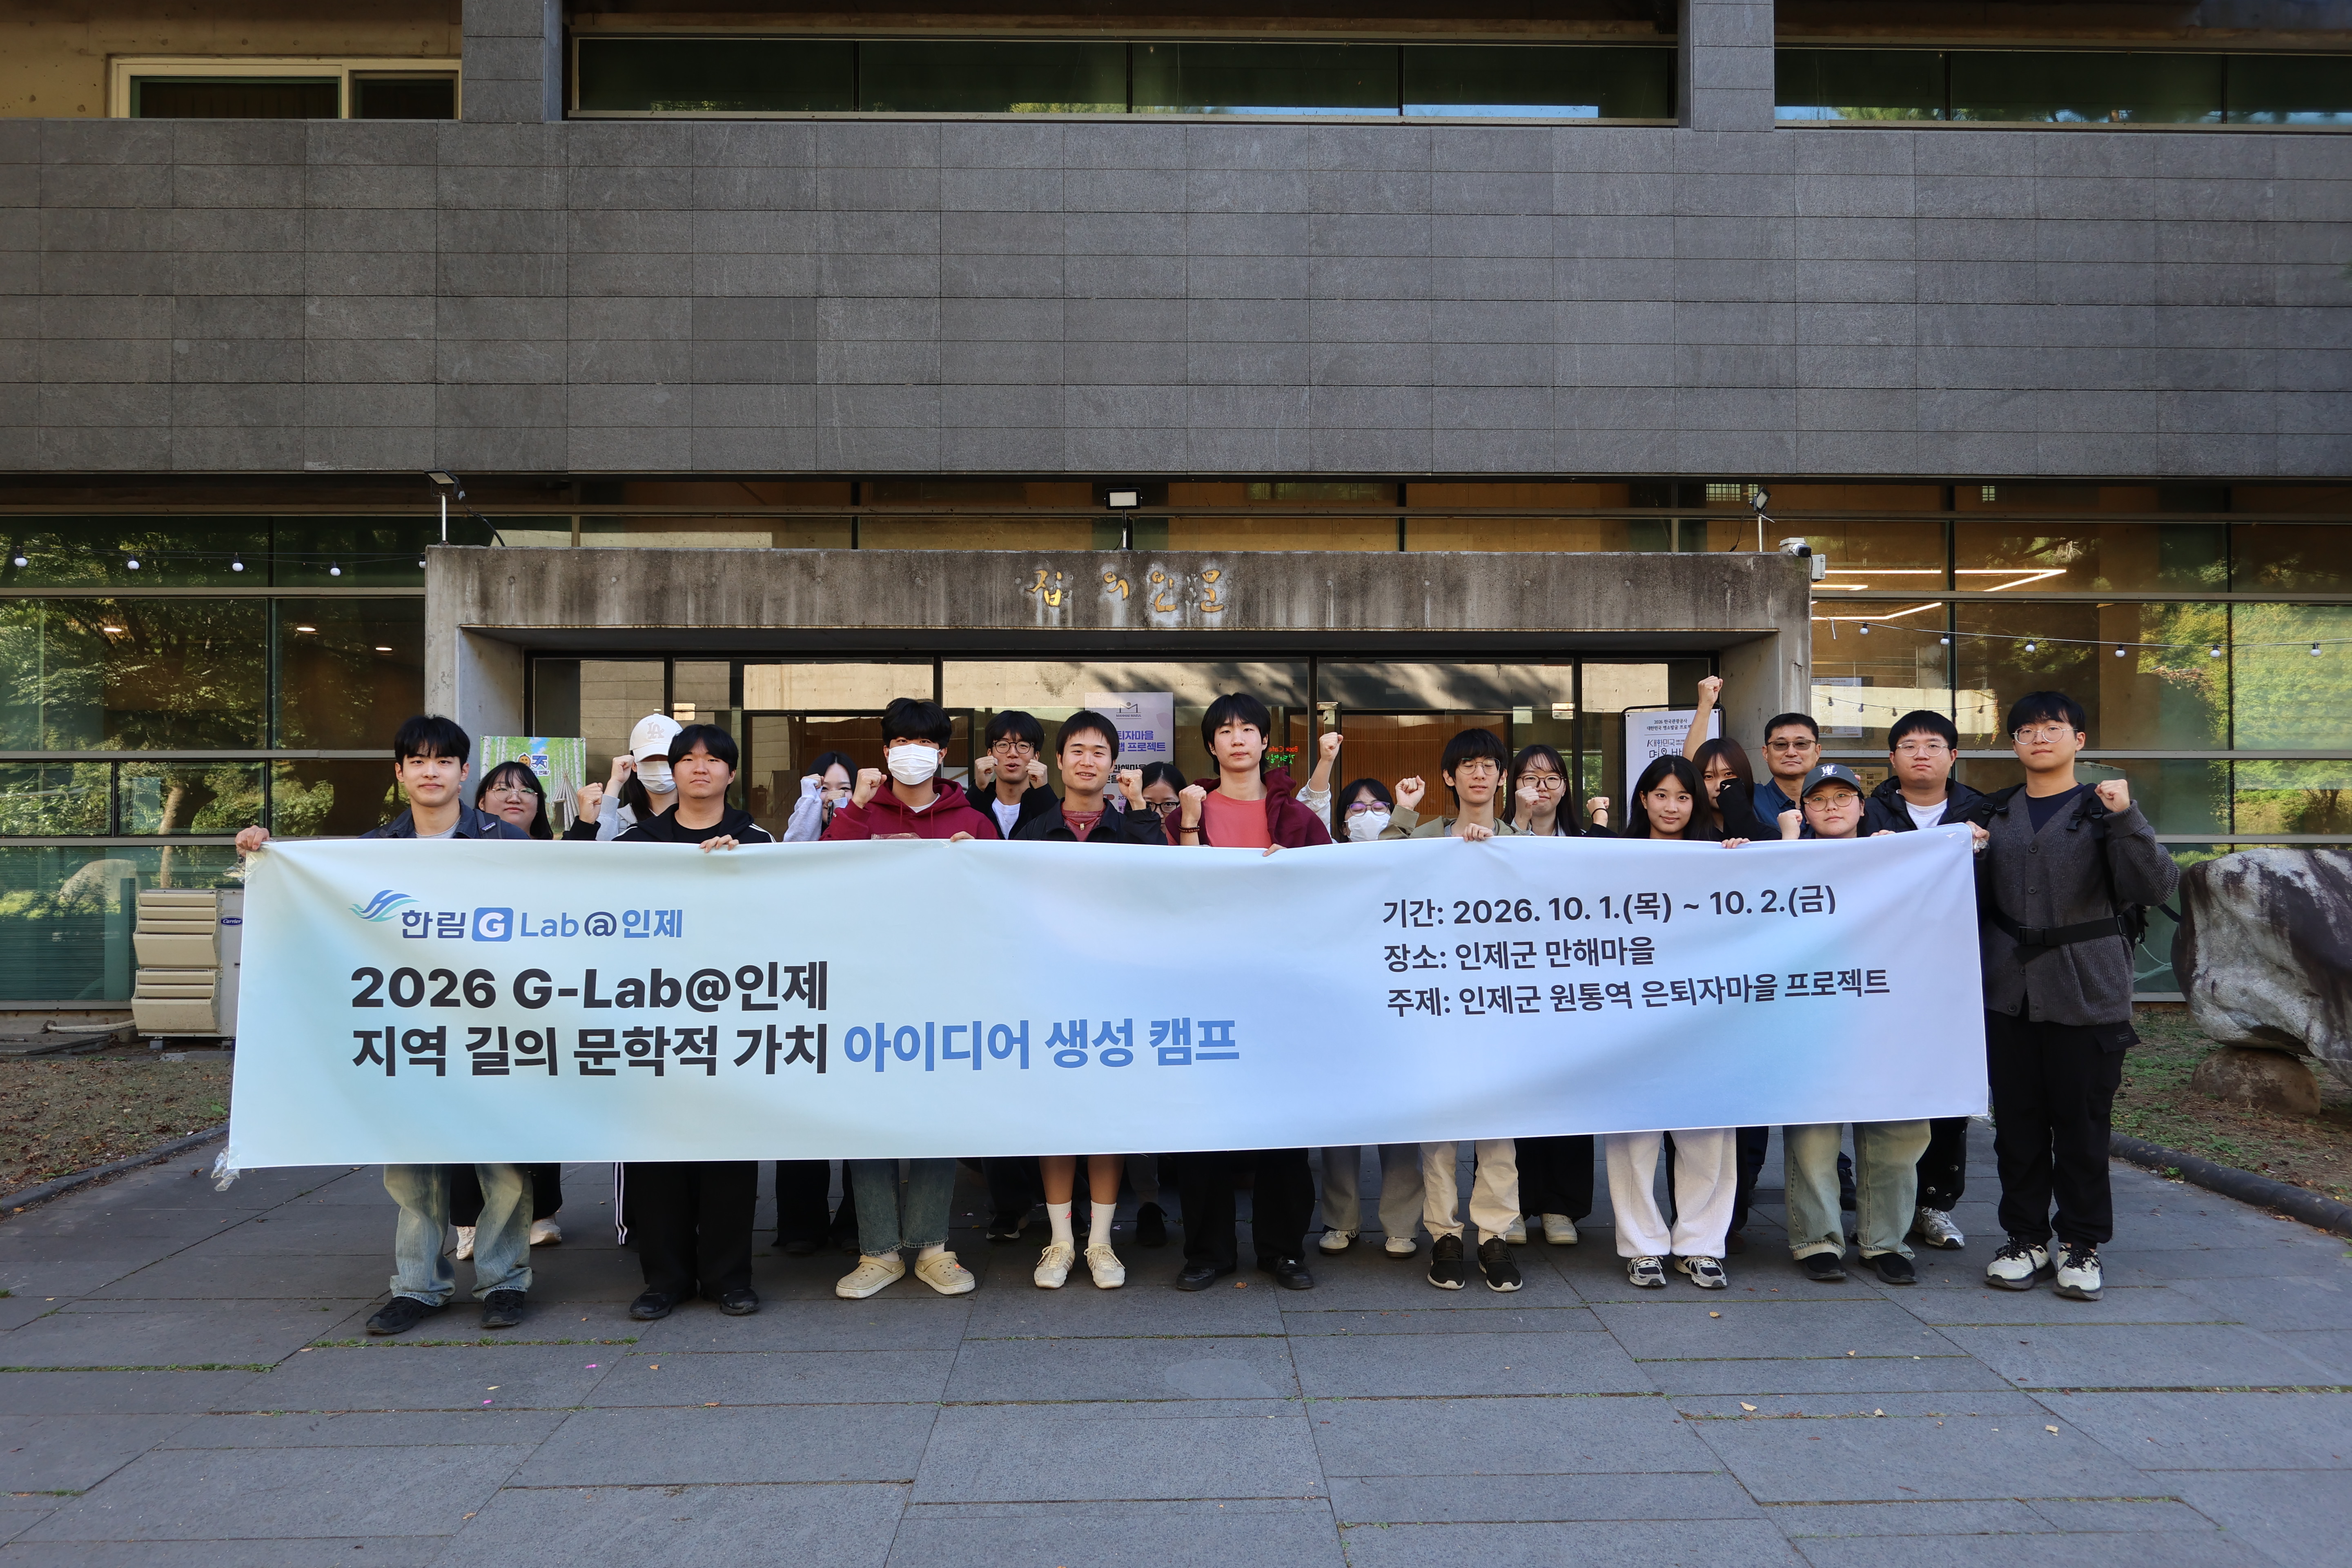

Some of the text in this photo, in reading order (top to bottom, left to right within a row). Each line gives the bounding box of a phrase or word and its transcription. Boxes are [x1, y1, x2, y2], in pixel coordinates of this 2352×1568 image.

[1127, 742, 1166, 752] 프로젝트
[402, 910, 466, 939] 한림
[1383, 899, 1443, 928] 기간:
[1453, 898, 1540, 924] 2026.
[1548, 897, 1590, 921] 10.
[1599, 892, 1672, 924] 1.(목)
[1709, 891, 1753, 915] 10.
[1761, 885, 1836, 917] 2.(금)
[1384, 936, 1655, 972] 장소: 인제군 만해마을
[351, 961, 827, 1013] 2026 G-Lab@인제
[1388, 968, 1890, 1017] 주제: 인제군 원통역 은퇴자마을 프로젝트
[352, 1017, 1240, 1077] 지역 길의 문학적 가치 아이디어 생성 캠프
